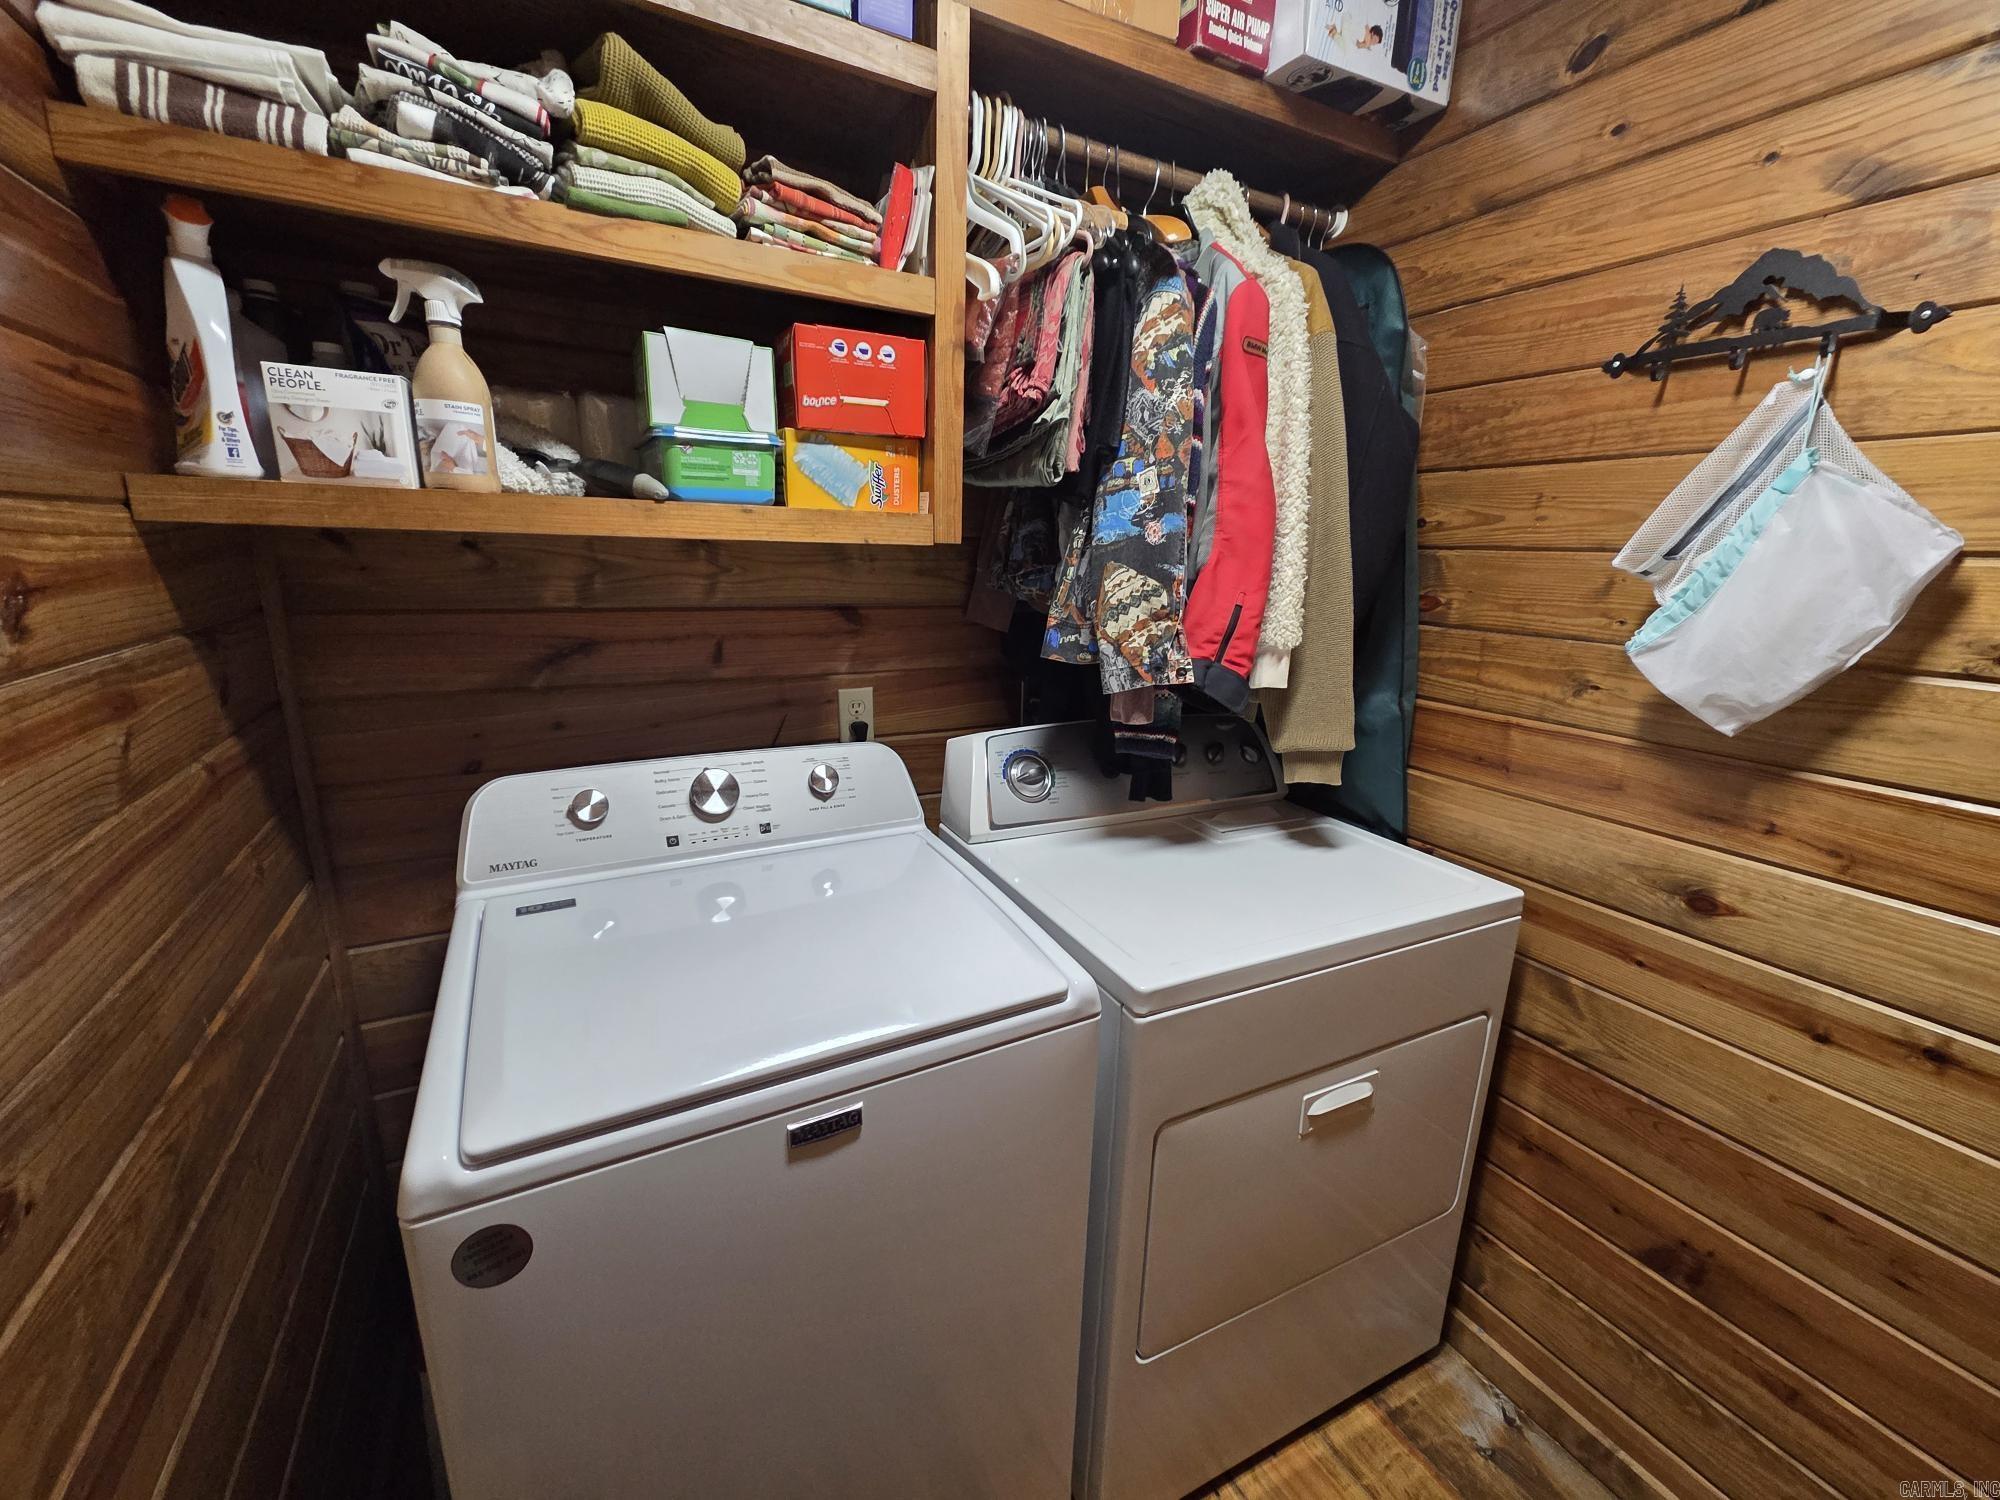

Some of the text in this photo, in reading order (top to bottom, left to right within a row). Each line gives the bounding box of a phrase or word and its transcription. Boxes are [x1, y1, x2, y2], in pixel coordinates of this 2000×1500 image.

[1206, 0, 1270, 39] SUPER AIR PUMP
[1437, 35, 1446, 60] Air
[1442, 0, 1458, 80] Queen Size
[1432, 64, 1442, 92] Bed
[267, 366, 314, 380] CLEAN
[335, 372, 377, 382] FRAGRANCE
[802, 394, 838, 408] bounce
[871, 461, 886, 511] Swiffer
[893, 467, 901, 506] DUSTERS
[488, 858, 538, 874] MAYTAG
